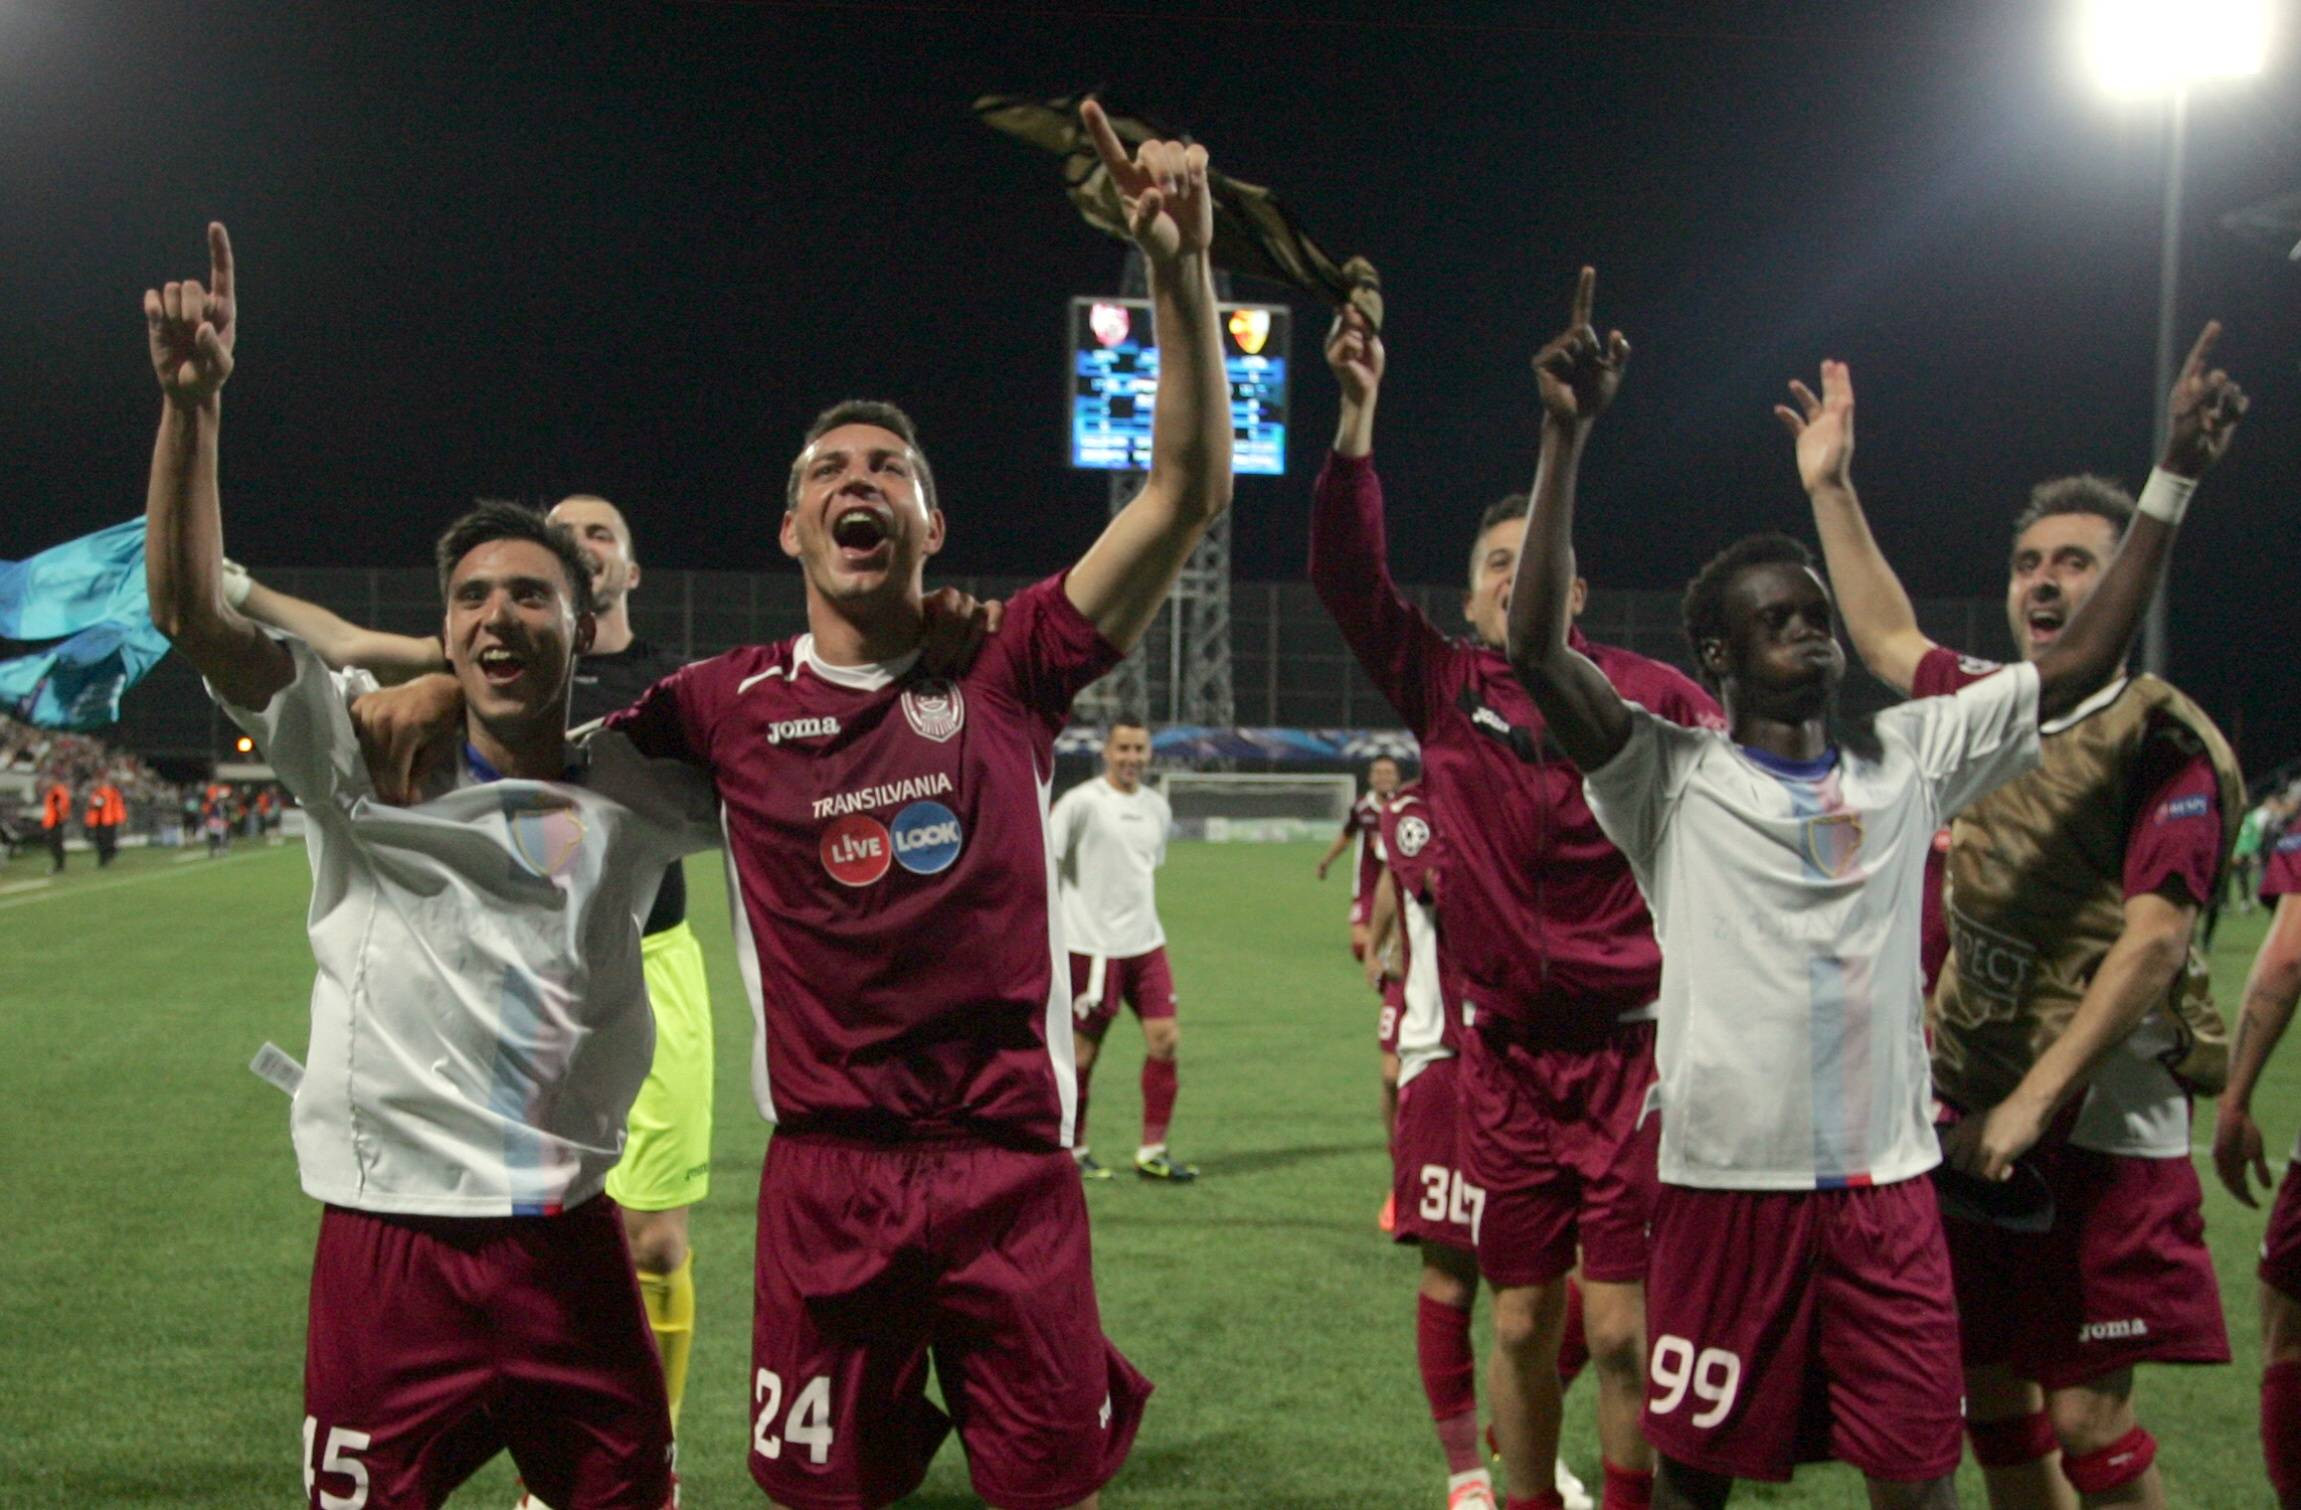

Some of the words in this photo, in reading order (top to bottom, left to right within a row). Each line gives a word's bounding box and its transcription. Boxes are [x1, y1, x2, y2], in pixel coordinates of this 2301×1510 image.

[812, 772, 953, 819] TRANSILVANIA
[894, 820, 960, 852] LOOK
[753, 1366, 834, 1466] 24
[1648, 1334, 1741, 1429] 99
